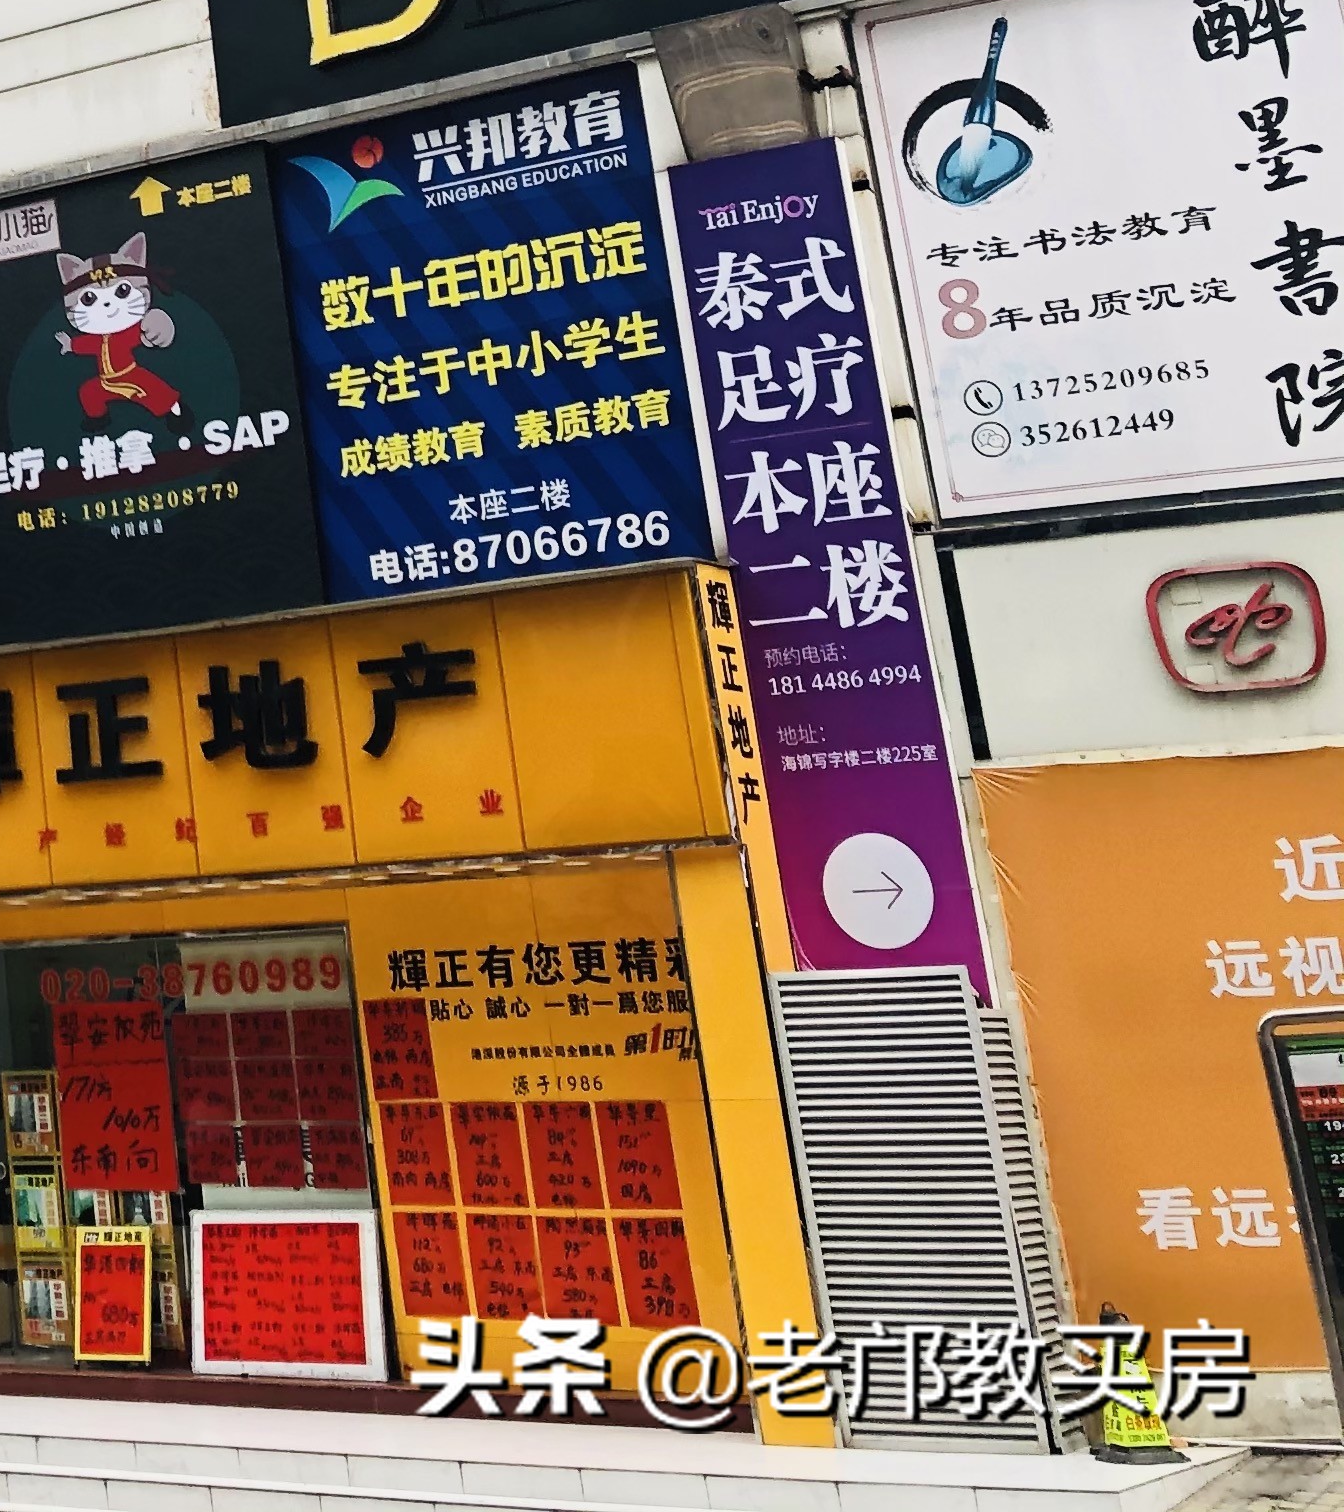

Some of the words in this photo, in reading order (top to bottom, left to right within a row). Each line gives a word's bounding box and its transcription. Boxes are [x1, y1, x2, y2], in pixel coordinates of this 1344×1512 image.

[413, 89, 626, 183] 兴邦教育
[176, 173, 253, 208] 本座二楼
[425, 176, 518, 208] XINGBANG
[522, 153, 628, 187] EDUCATION
[698, 202, 740, 232] Tai
[926, 205, 1217, 268] 专注书法教育
[320, 221, 648, 332] 数十年的沉淀
[694, 236, 856, 333] 泰式
[937, 277, 1237, 340] 8年品质沉淀
[326, 310, 667, 410] 专注于中小学生
[717, 333, 865, 431] 足疗
[1012, 359, 1211, 403] 13725209685
[341, 420, 486, 479] 成绩教育
[515, 388, 673, 451] 素质教育
[1019, 407, 1176, 448] 352612449
[448, 478, 572, 526] 本座二楼
[724, 441, 894, 535] 本座
[369, 510, 671, 585] 电话:87066786
[749, 539, 910, 629] 二楼
[768, 676, 806, 697] 181
[811, 669, 864, 691] 4486
[868, 664, 922, 688] 4994
[776, 724, 826, 747] 地址:
[780, 743, 939, 772] 海锦写字楼二楼225室
[1274, 833, 1344, 903] 近
[40, 954, 343, 1003] 020-38760989
[1206, 935, 1344, 1000] 远视
[624, 1023, 697, 1055] 第1时
[1136, 1185, 1301, 1252] 看远
